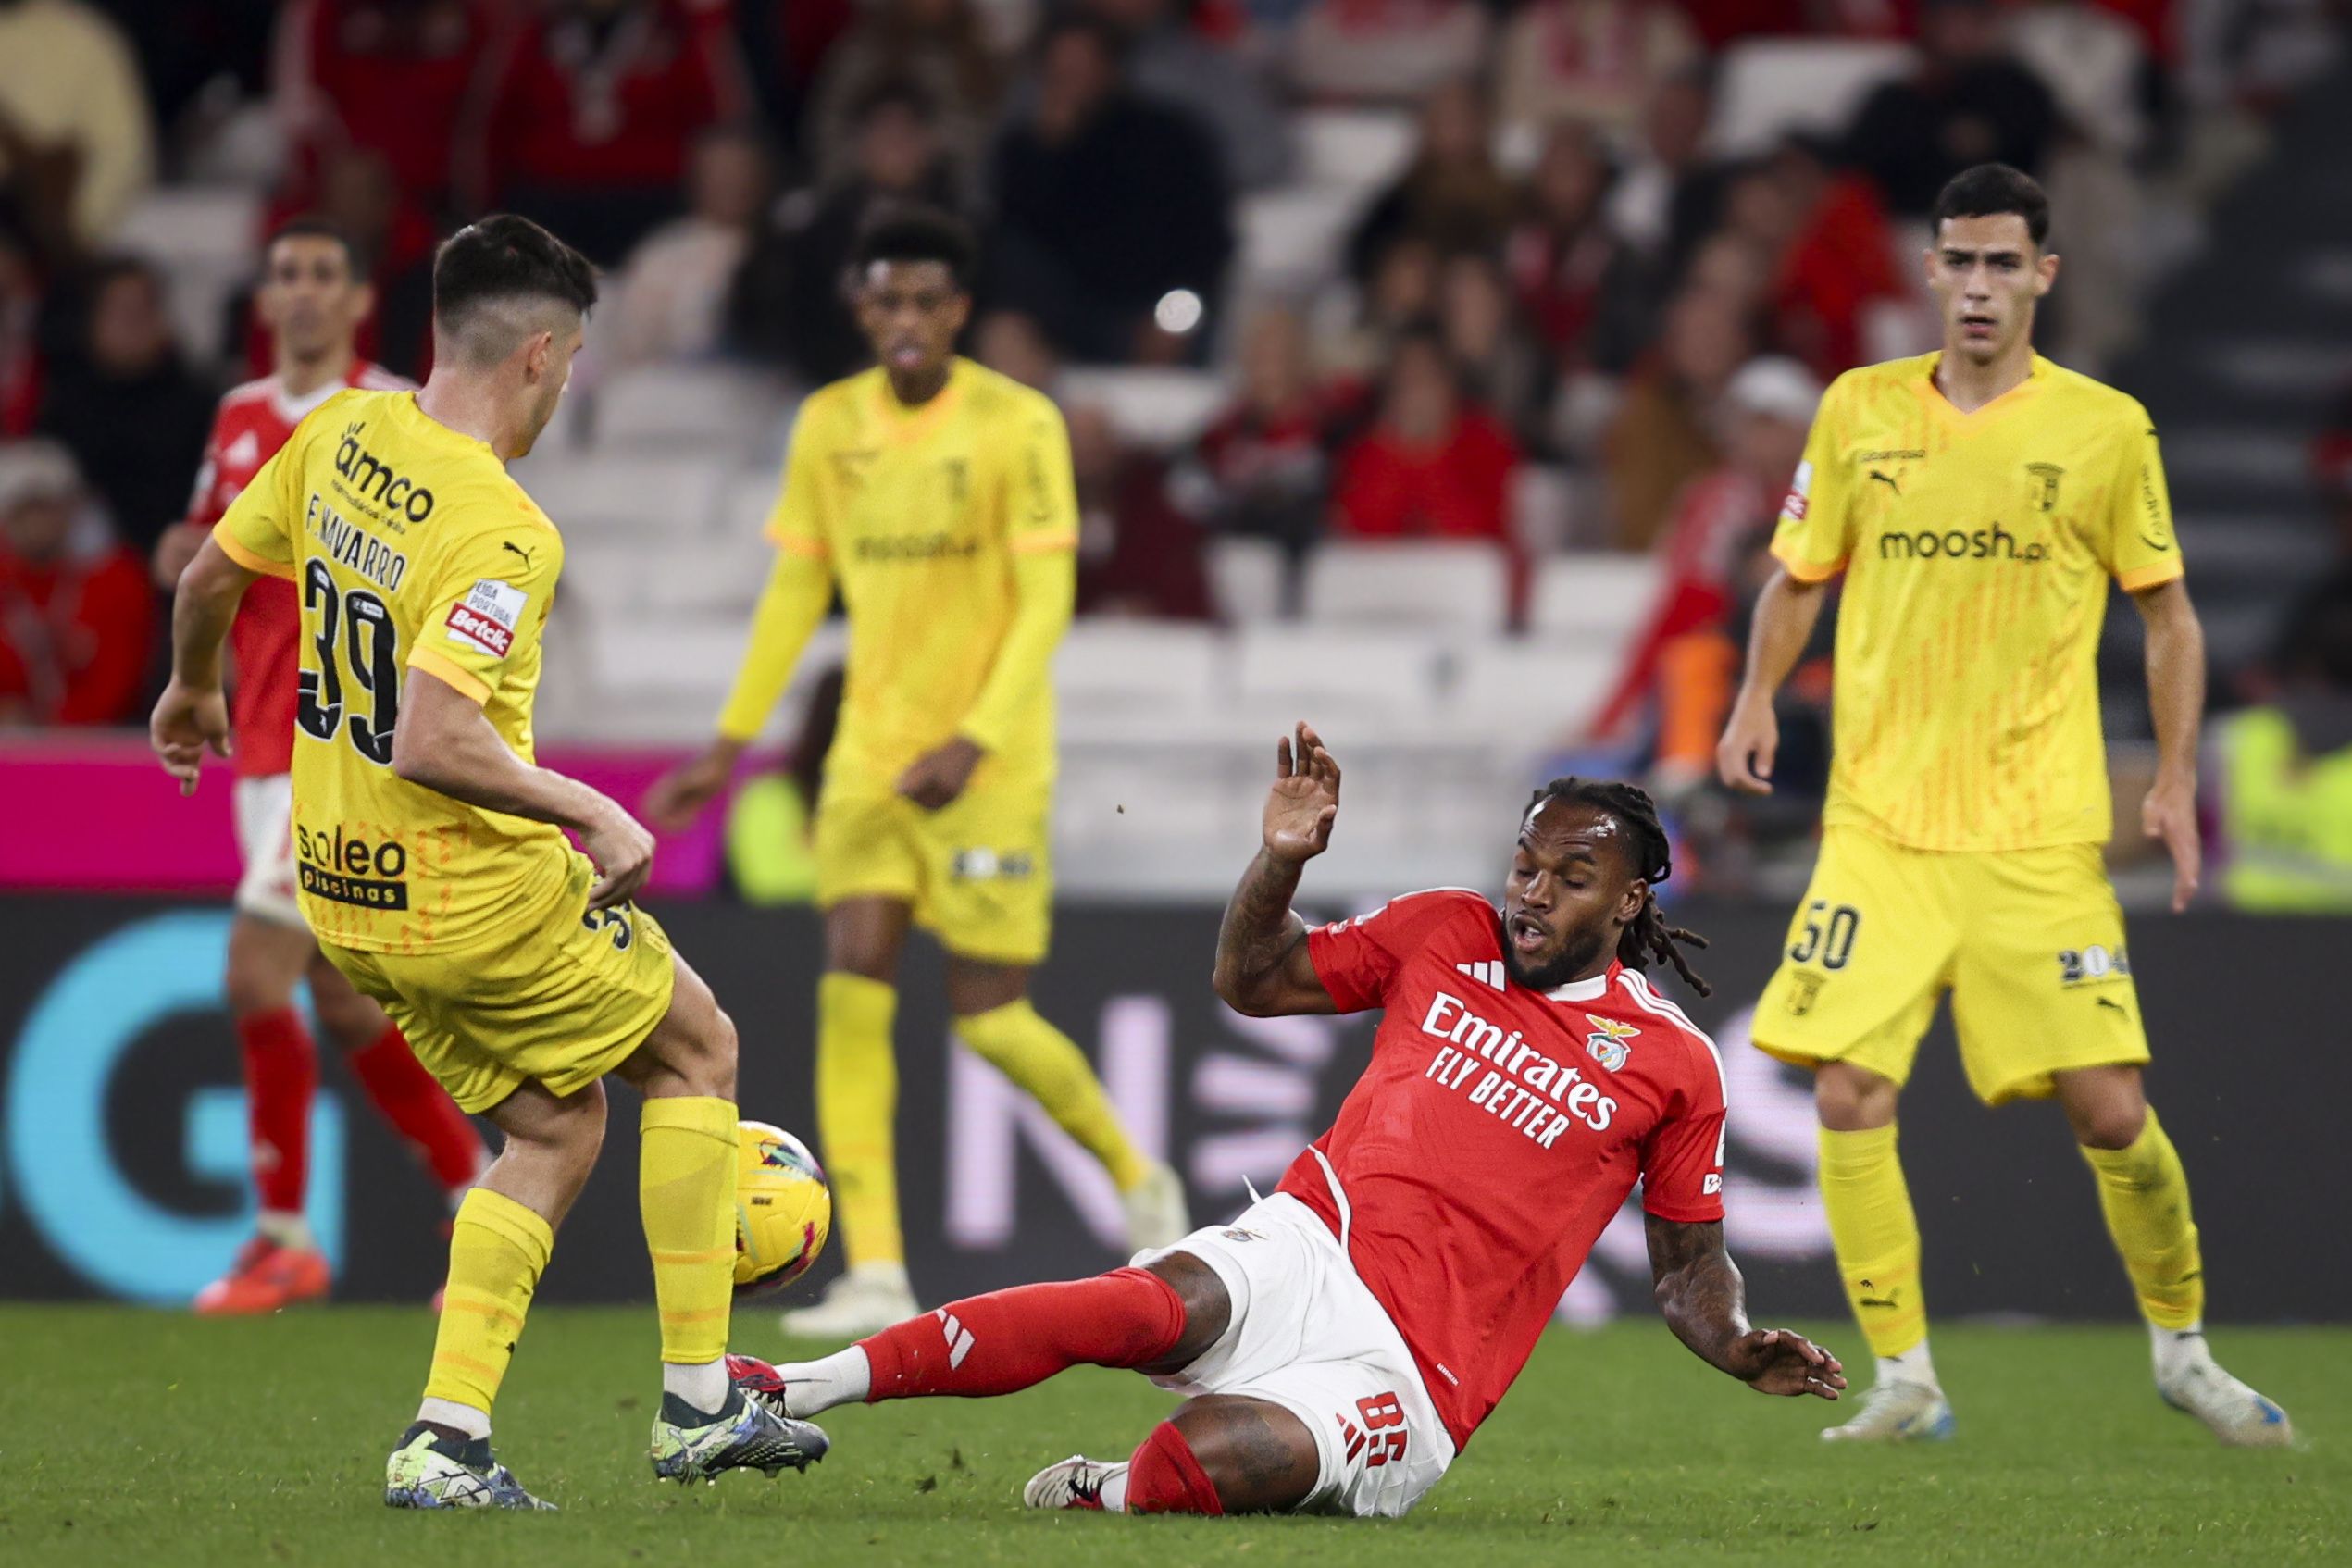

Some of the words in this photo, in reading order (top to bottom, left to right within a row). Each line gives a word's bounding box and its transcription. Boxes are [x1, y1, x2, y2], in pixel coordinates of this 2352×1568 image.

[297, 558, 398, 765] 39
[297, 824, 406, 877] soleo
[304, 870, 396, 903] piscinas
[1791, 902, 1859, 970] 50
[1421, 990, 1619, 1131] Emirates
[1425, 1045, 1481, 1090] FLY
[1467, 1070, 1571, 1150] BETTER
[1355, 1390, 1408, 1470] 85
